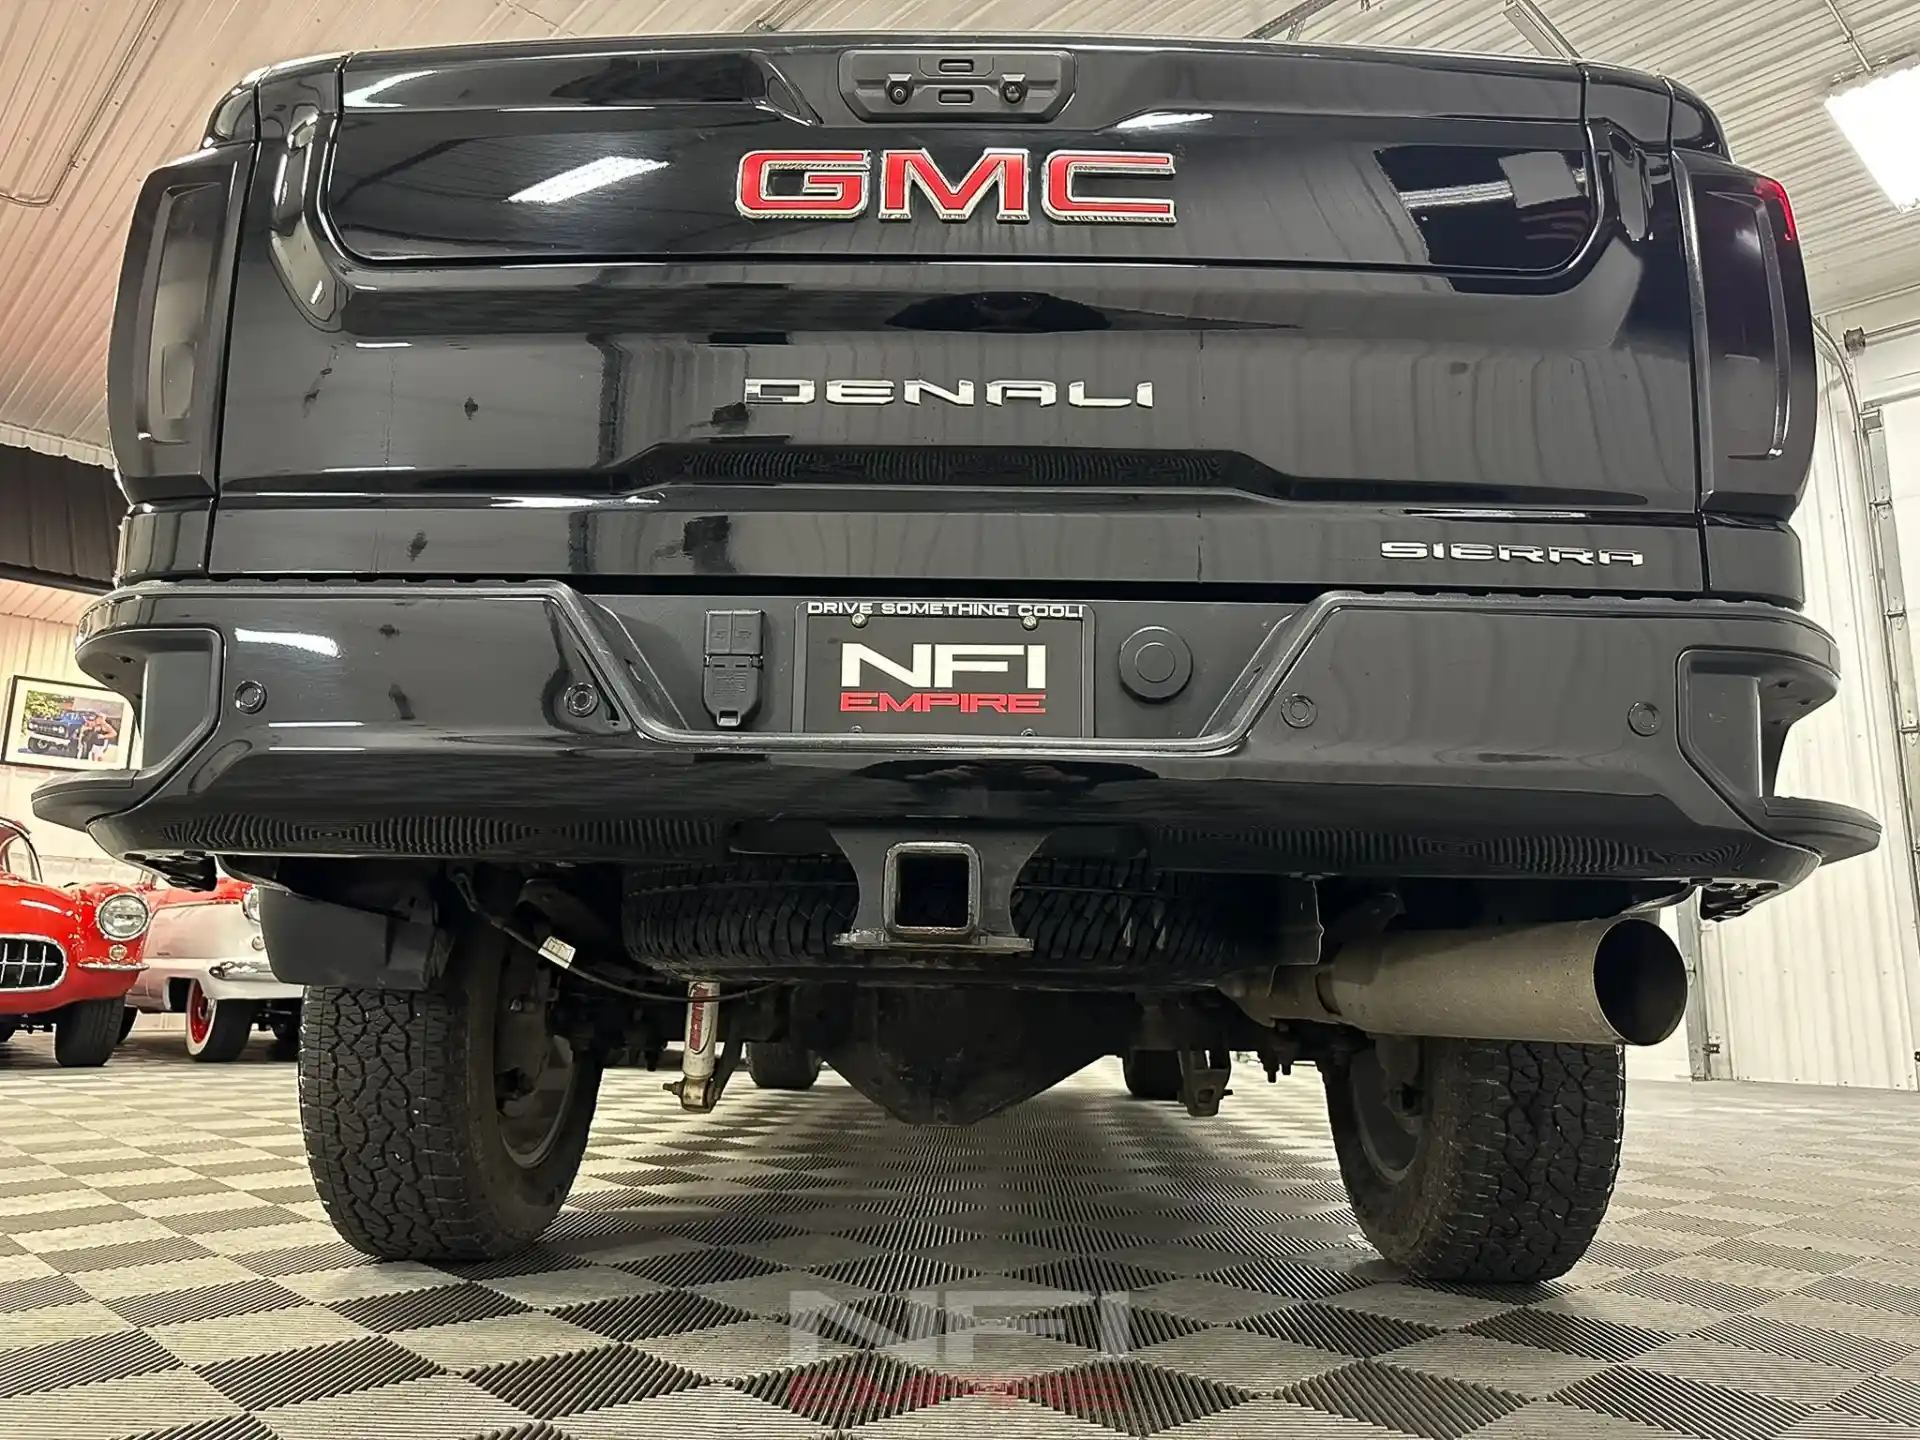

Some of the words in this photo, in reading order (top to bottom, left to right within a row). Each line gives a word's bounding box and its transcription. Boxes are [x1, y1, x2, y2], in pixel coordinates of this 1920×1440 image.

[735, 147, 1177, 224] GMC
[744, 379, 1154, 408] DENALI
[1381, 541, 1643, 567] SIERRA
[807, 601, 873, 615] DRIVE
[881, 602, 1010, 617] SOMETHING
[1017, 603, 1084, 618] COOL!
[840, 642, 1047, 689] NFI
[839, 691, 1047, 713] EMPIRE
